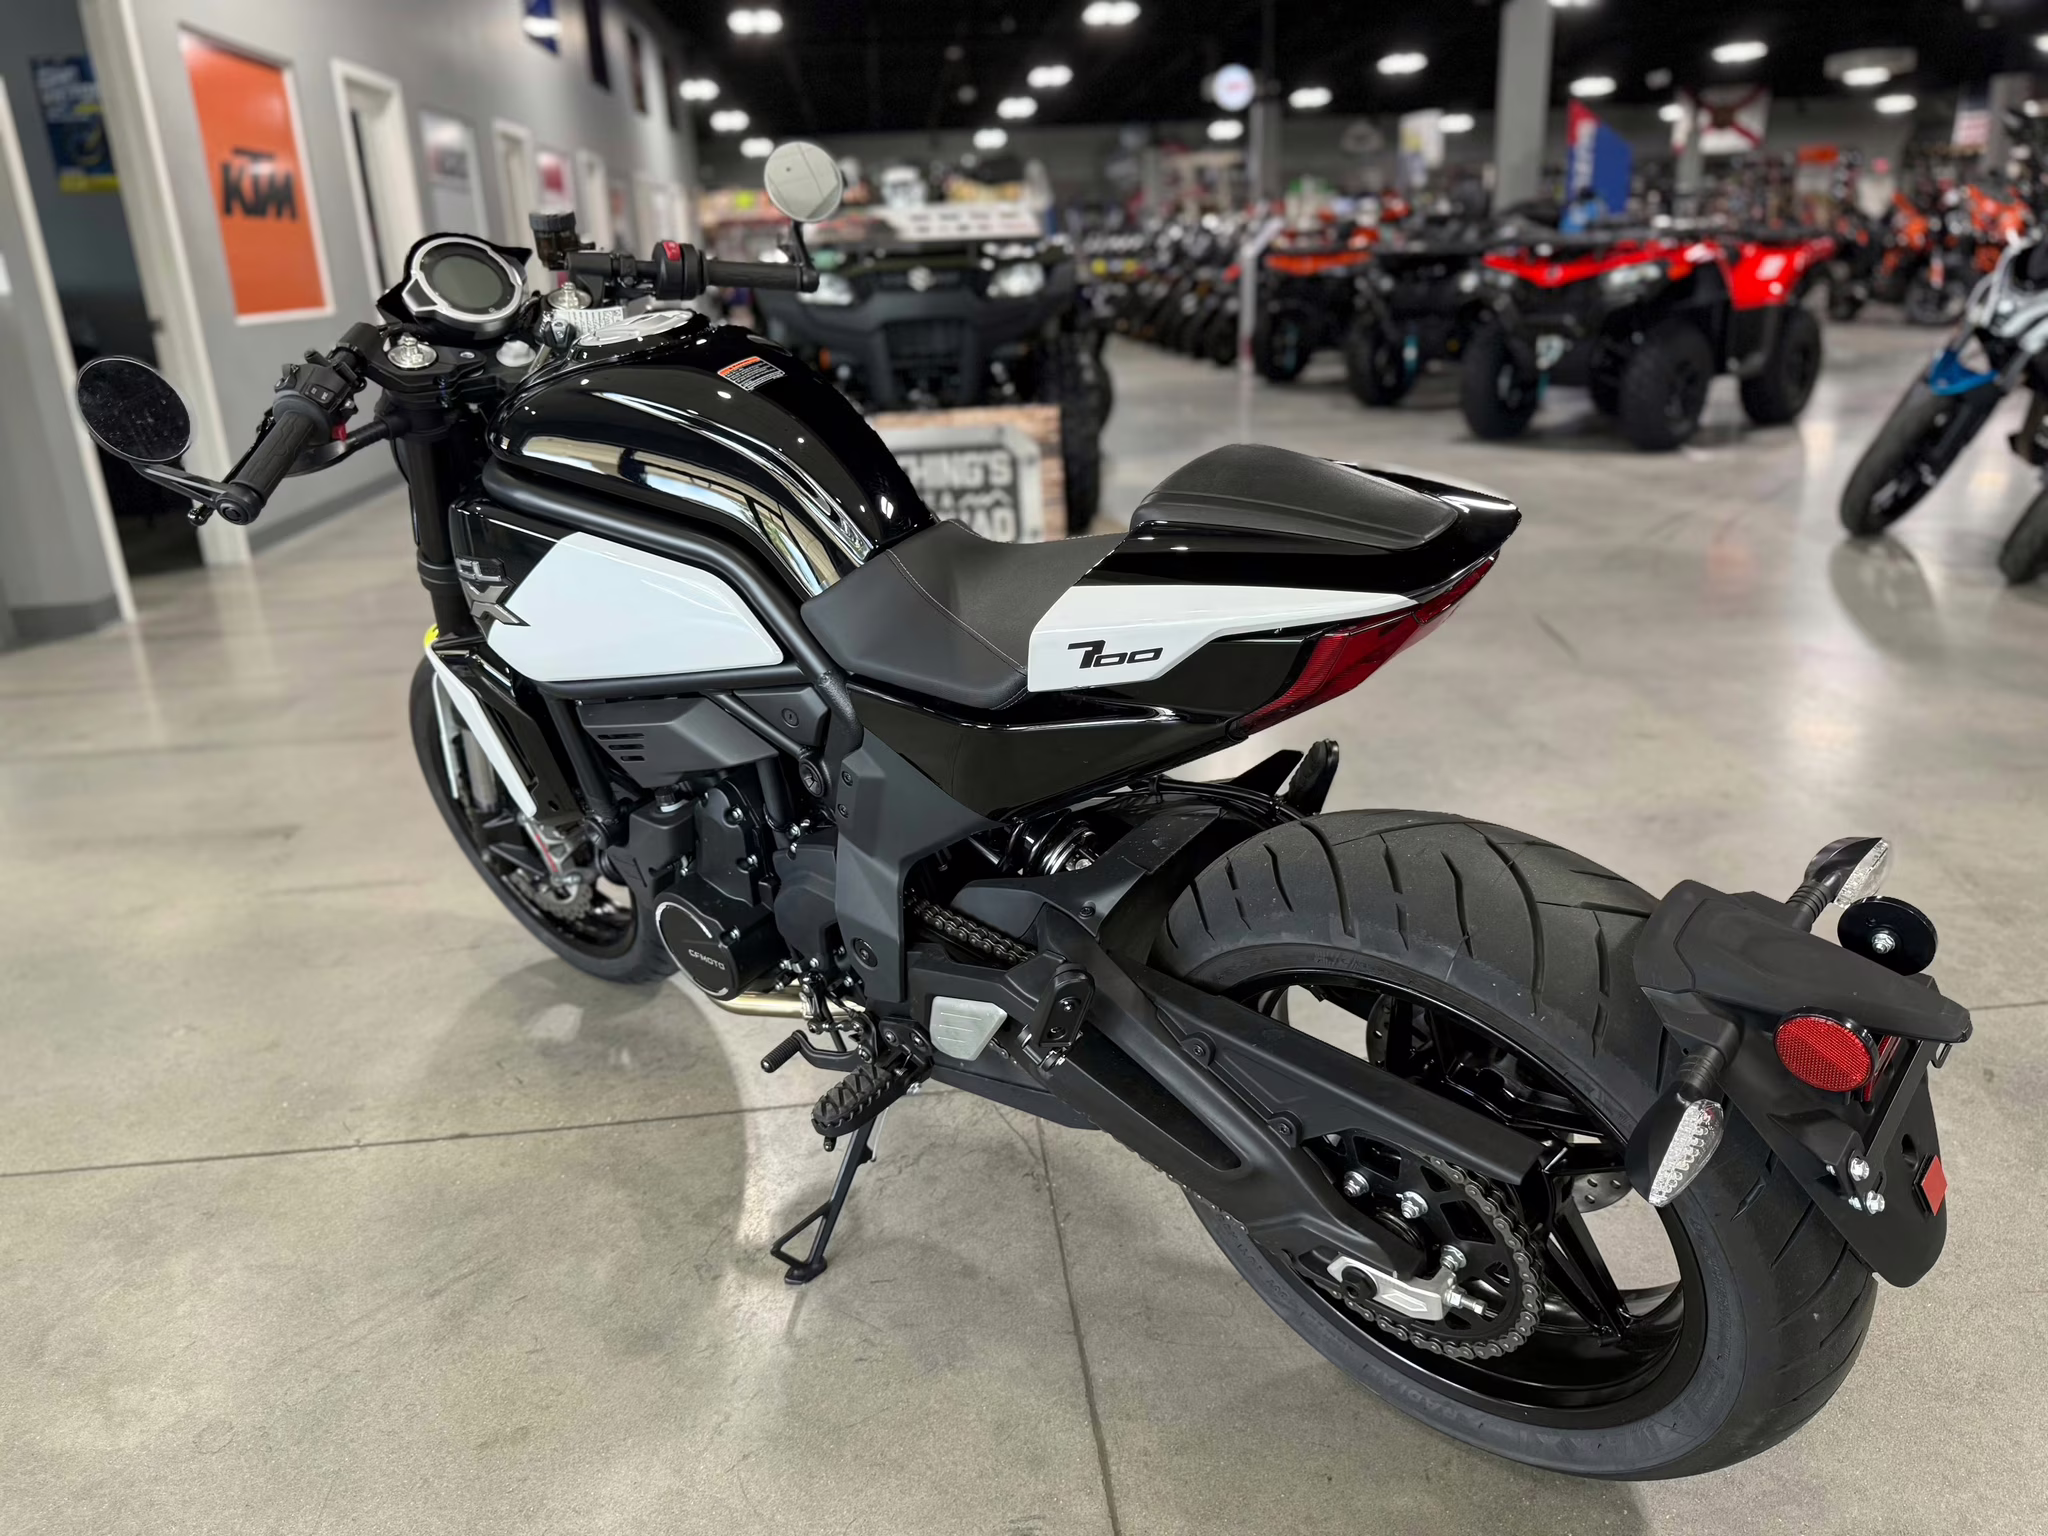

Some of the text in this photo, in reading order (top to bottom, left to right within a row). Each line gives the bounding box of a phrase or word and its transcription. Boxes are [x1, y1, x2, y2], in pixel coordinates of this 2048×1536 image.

[222, 147, 297, 222] KTM
[1067, 639, 1164, 669] 700
[688, 948, 726, 971] CFMOTO
